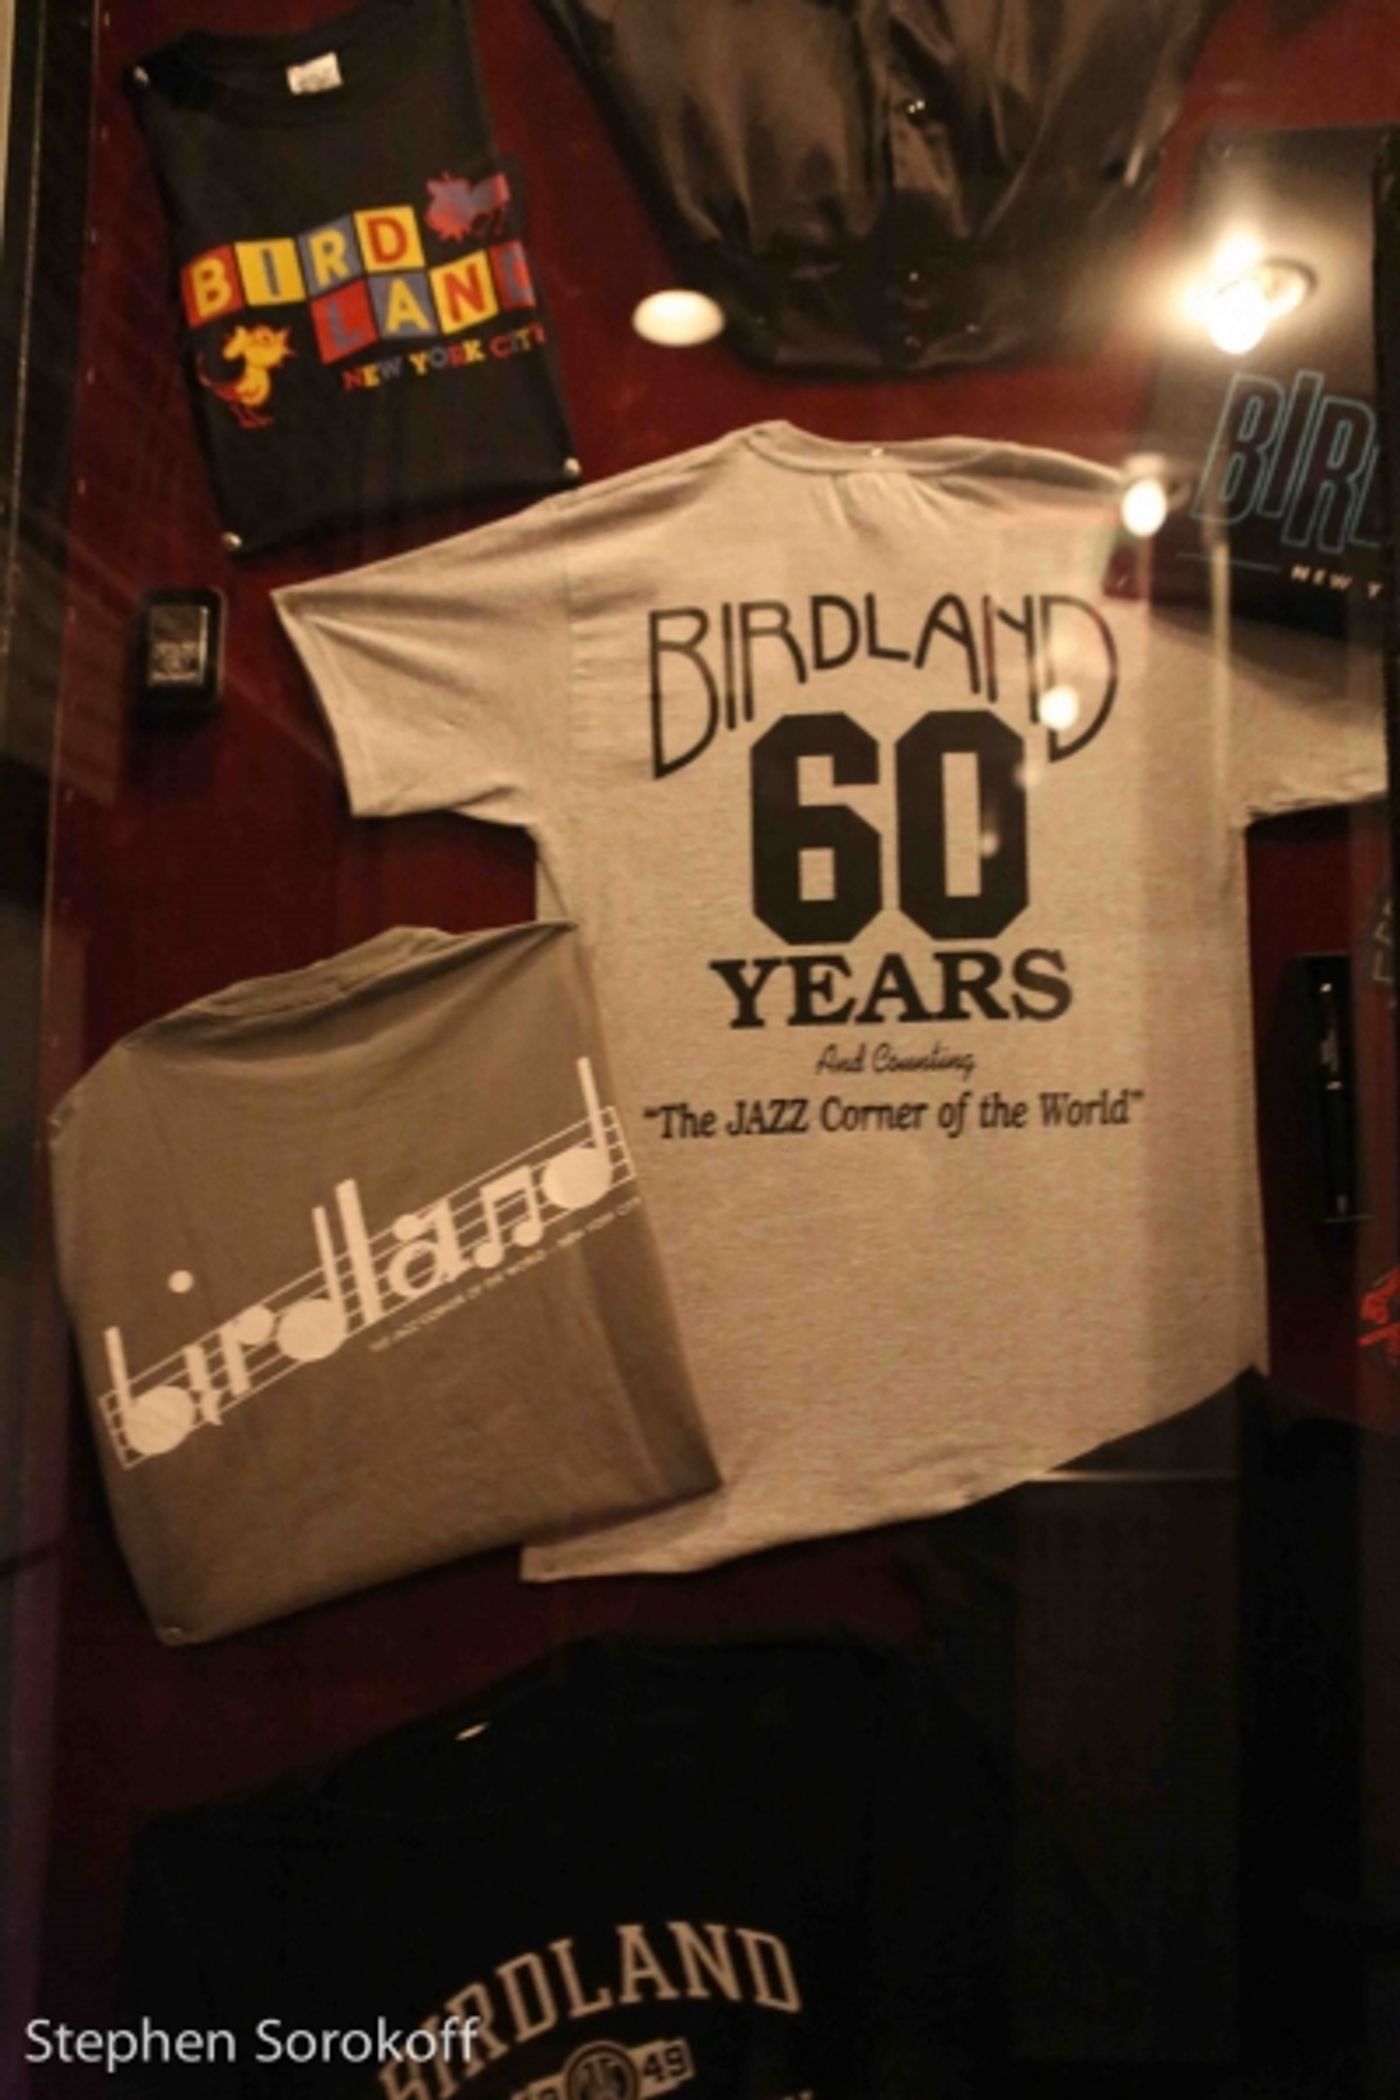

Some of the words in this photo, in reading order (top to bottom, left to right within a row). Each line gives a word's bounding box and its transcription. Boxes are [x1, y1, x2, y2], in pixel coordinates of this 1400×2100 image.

[190, 215, 408, 319] BIRD
[342, 357, 402, 391] NEW
[408, 338, 486, 376] YORK
[1190, 368, 1381, 555] BIR
[648, 592, 1119, 781] BIRDLAND
[749, 709, 1030, 946] 60
[709, 948, 1073, 1030] YEARS
[815, 1043, 866, 1076] And
[871, 1042, 977, 1082] Counting
[643, 1101, 717, 1140] "The
[725, 1098, 810, 1136] JAZZ
[819, 1095, 929, 1133] Corner
[937, 1090, 974, 1139] of
[979, 1093, 1029, 1130] the
[1038, 1088, 1146, 1128] World"
[644, 2044, 690, 2083] 49
